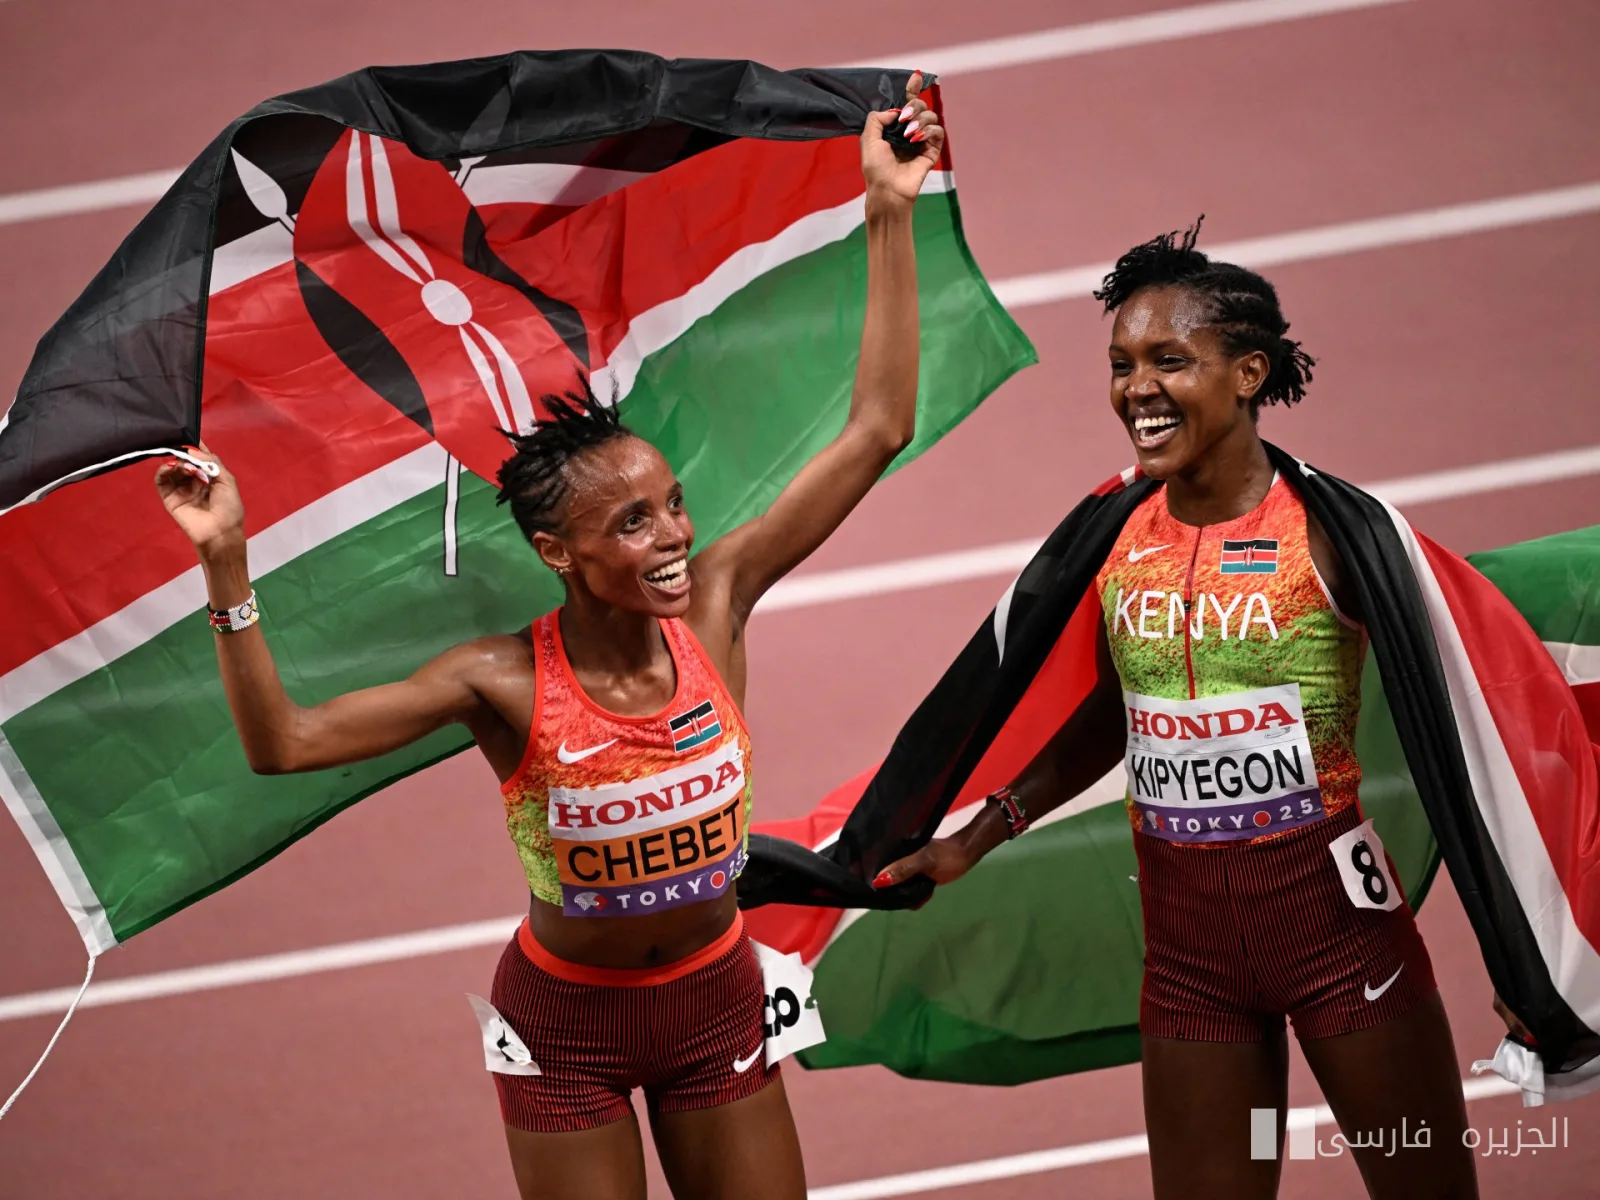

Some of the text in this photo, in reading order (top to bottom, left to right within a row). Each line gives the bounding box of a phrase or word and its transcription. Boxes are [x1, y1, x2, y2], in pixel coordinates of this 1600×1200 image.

[1113, 588, 1279, 641] KENYA
[1128, 702, 1299, 741] HONDA
[554, 760, 743, 829] HONDA
[1131, 745, 1306, 801] KIPYEGON
[567, 798, 741, 882] CHEBET
[1351, 840, 1389, 905] 8
